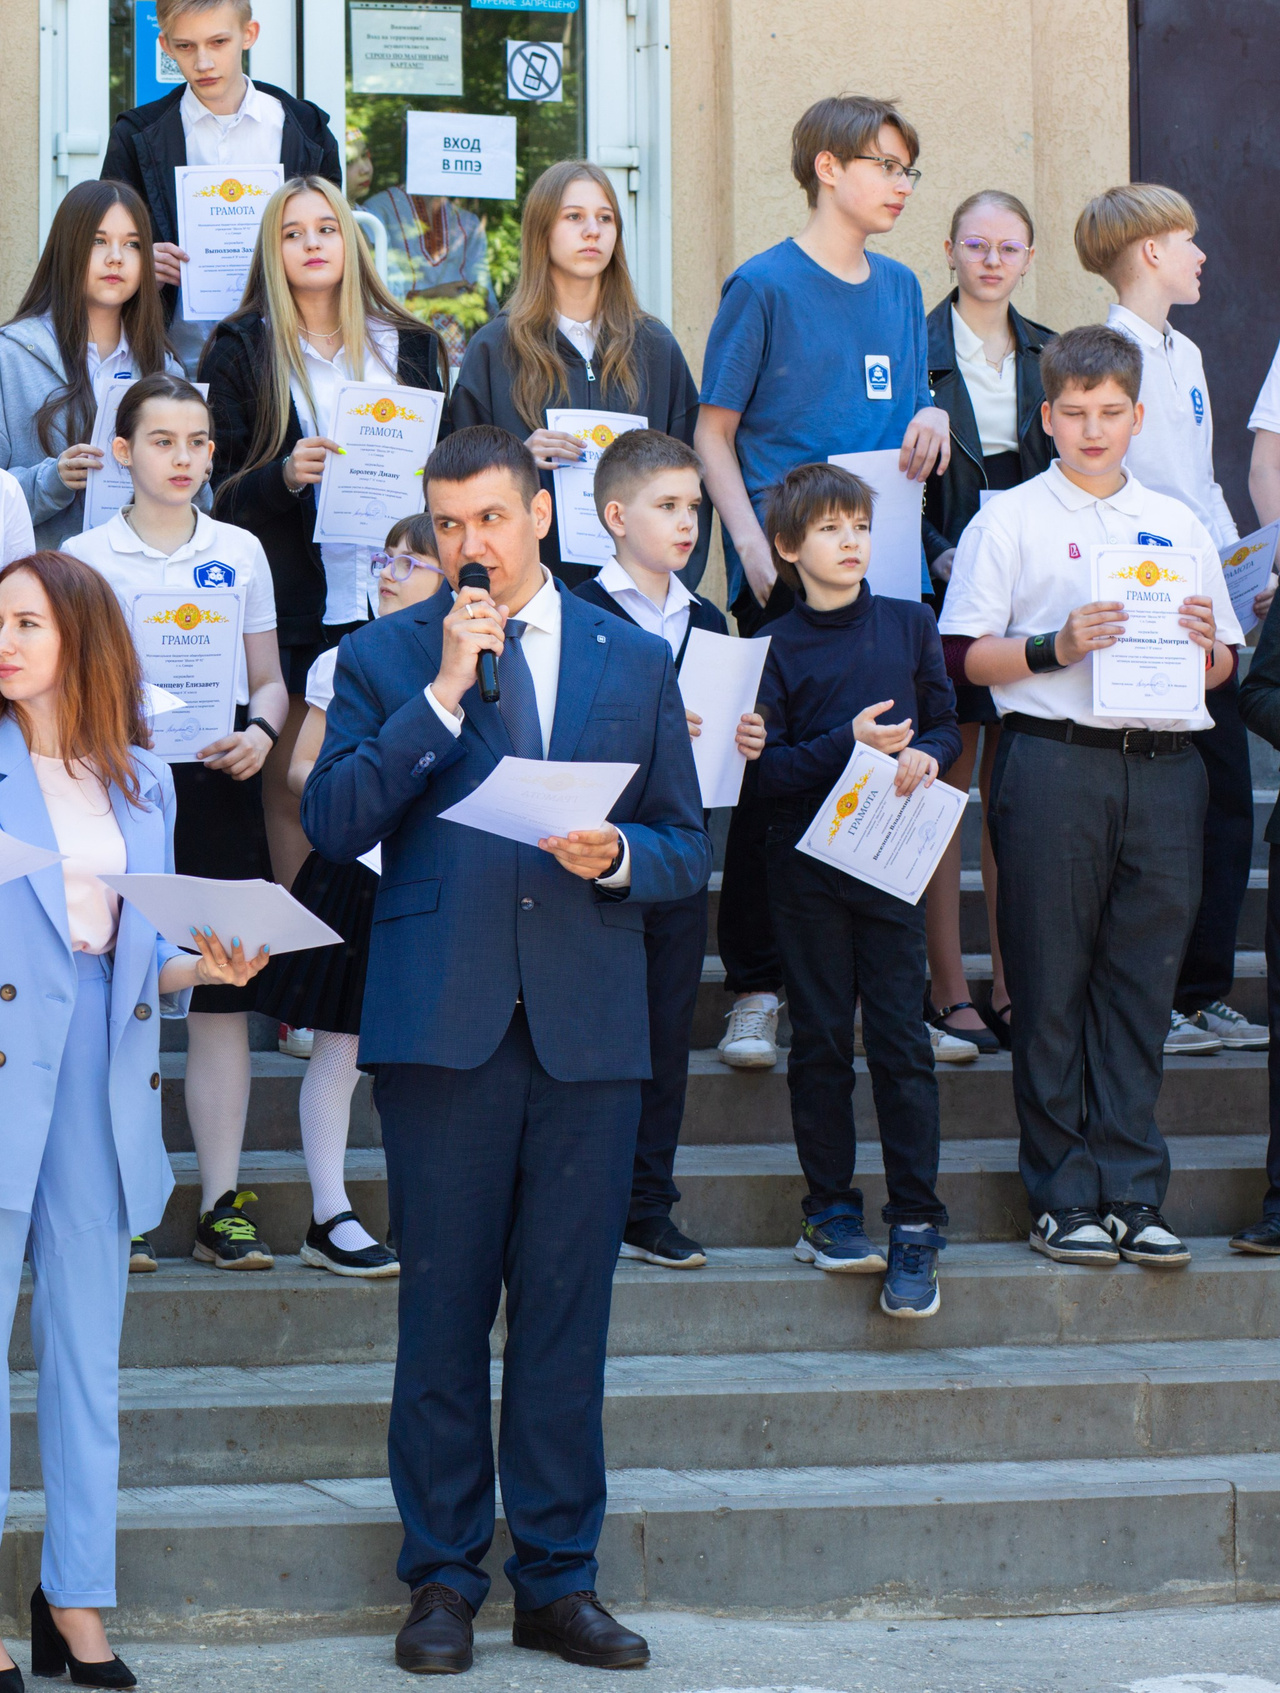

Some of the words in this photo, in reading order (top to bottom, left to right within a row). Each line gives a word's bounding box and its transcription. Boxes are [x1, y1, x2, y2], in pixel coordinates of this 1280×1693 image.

[520, 0, 576, 9] ЗАПРЕЩЕНО
[365, 52, 391, 60] СТРОГО
[443, 137, 481, 152] ВХОД
[442, 159, 451, 171] В
[454, 160, 482, 172] ППЭ
[210, 206, 255, 216] ГРАМОТА
[359, 426, 403, 439] ГРАМОТА
[349, 469, 377, 477] Королеву
[378, 470, 400, 479] Диану
[1126, 590, 1171, 602] ГРАМОТА
[161, 635, 210, 645] ГРАМОТА
[847, 790, 879, 836] ГРАМОТА
